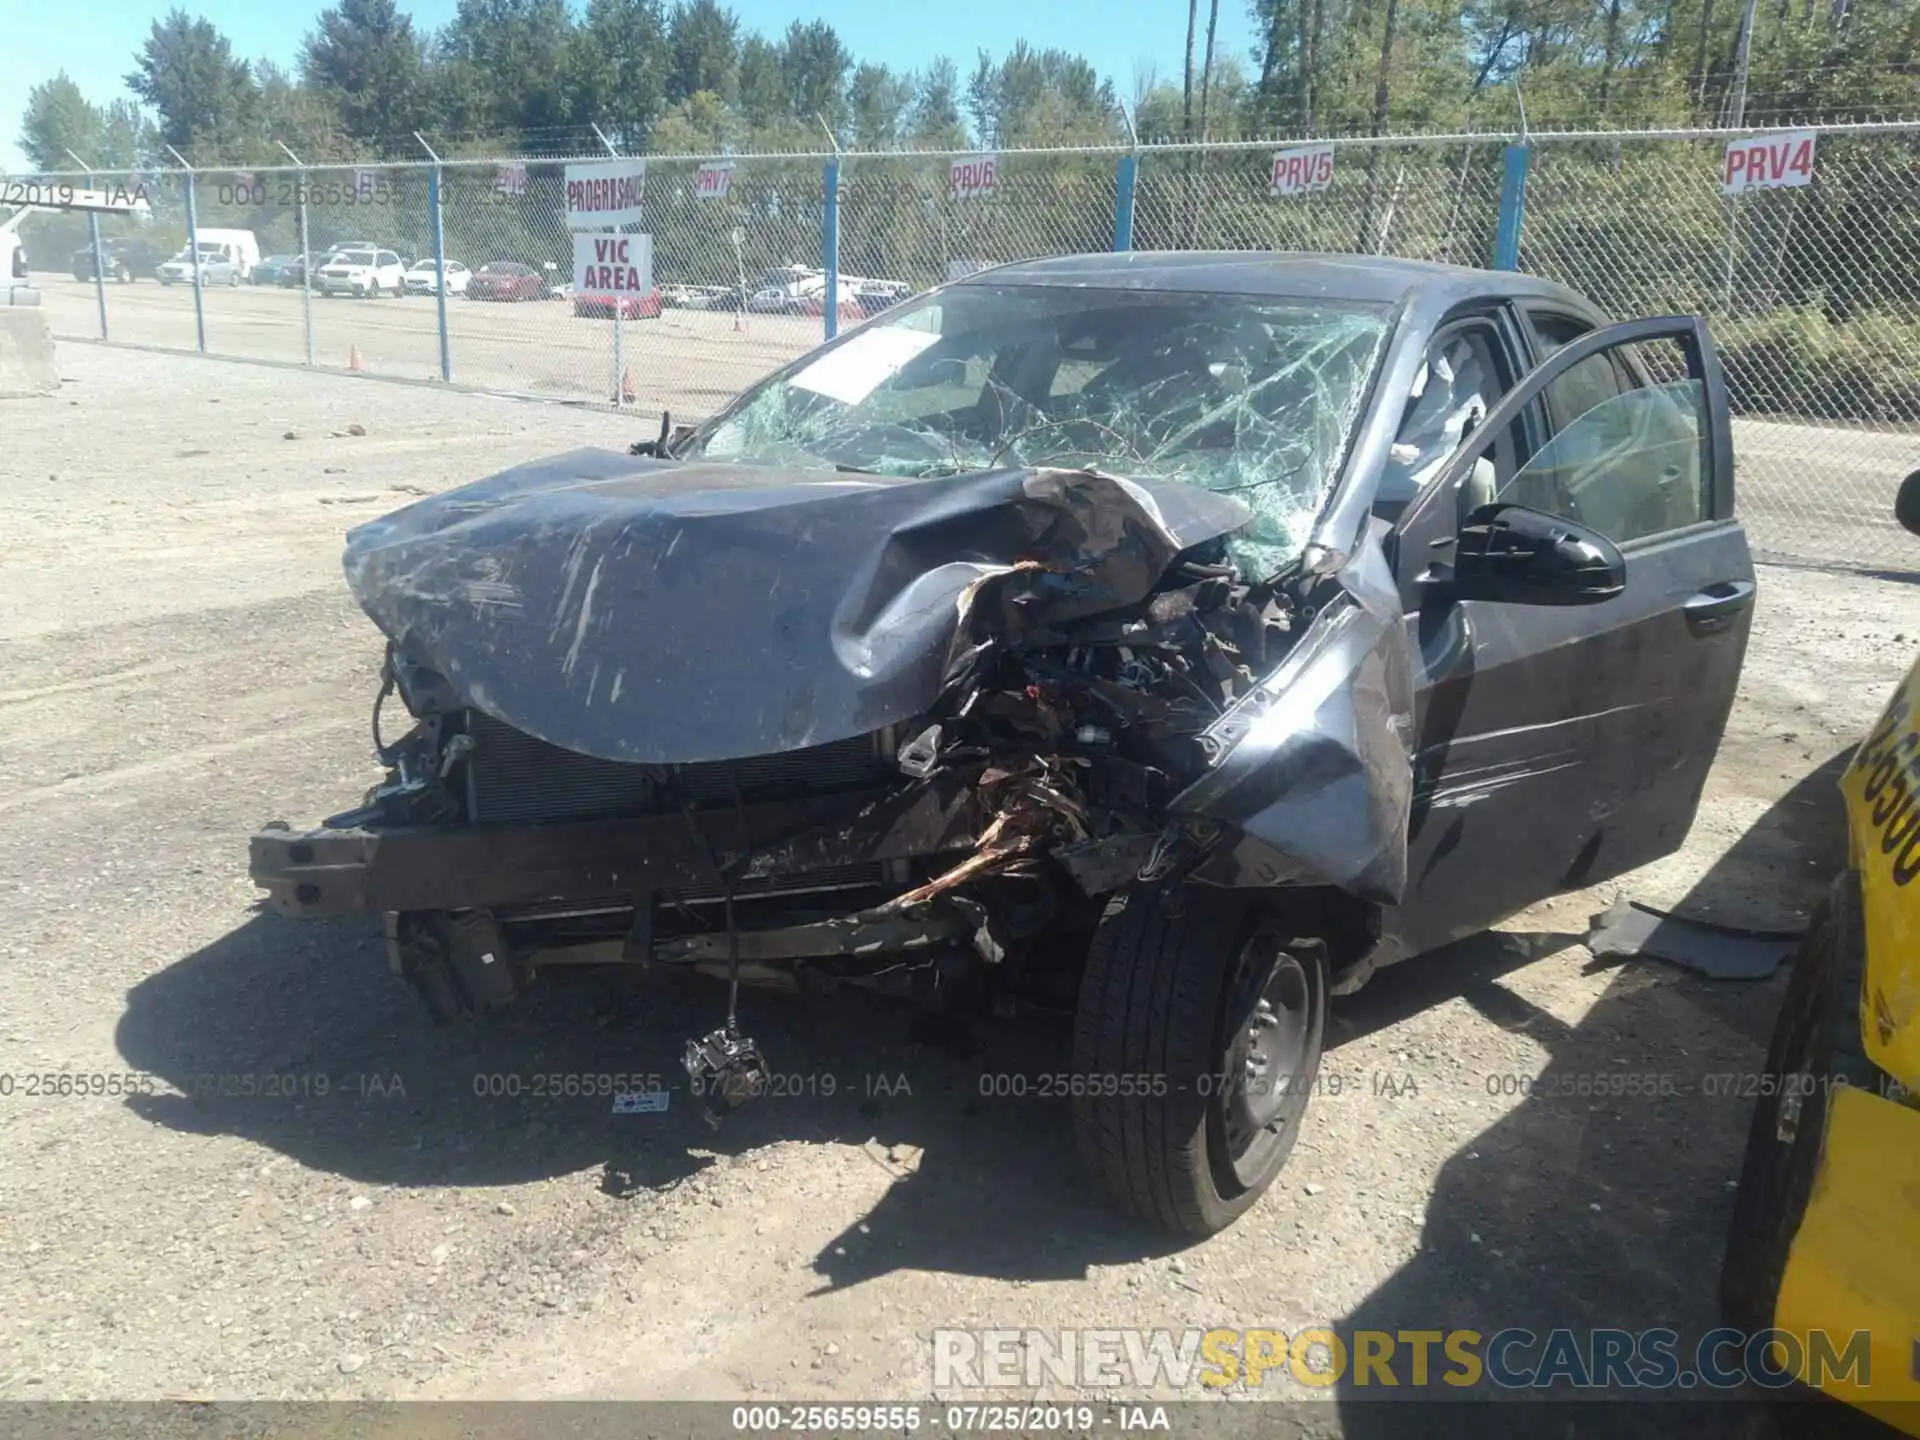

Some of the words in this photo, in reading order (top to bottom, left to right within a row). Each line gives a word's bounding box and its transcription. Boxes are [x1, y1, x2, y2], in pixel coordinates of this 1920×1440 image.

[949, 161, 995, 190] PRV6
[1273, 152, 1332, 187] PRV5
[1726, 139, 1813, 186] PRV4
[696, 168, 730, 191] PRV7
[594, 239, 629, 263] VIC
[584, 265, 641, 291] AREA
